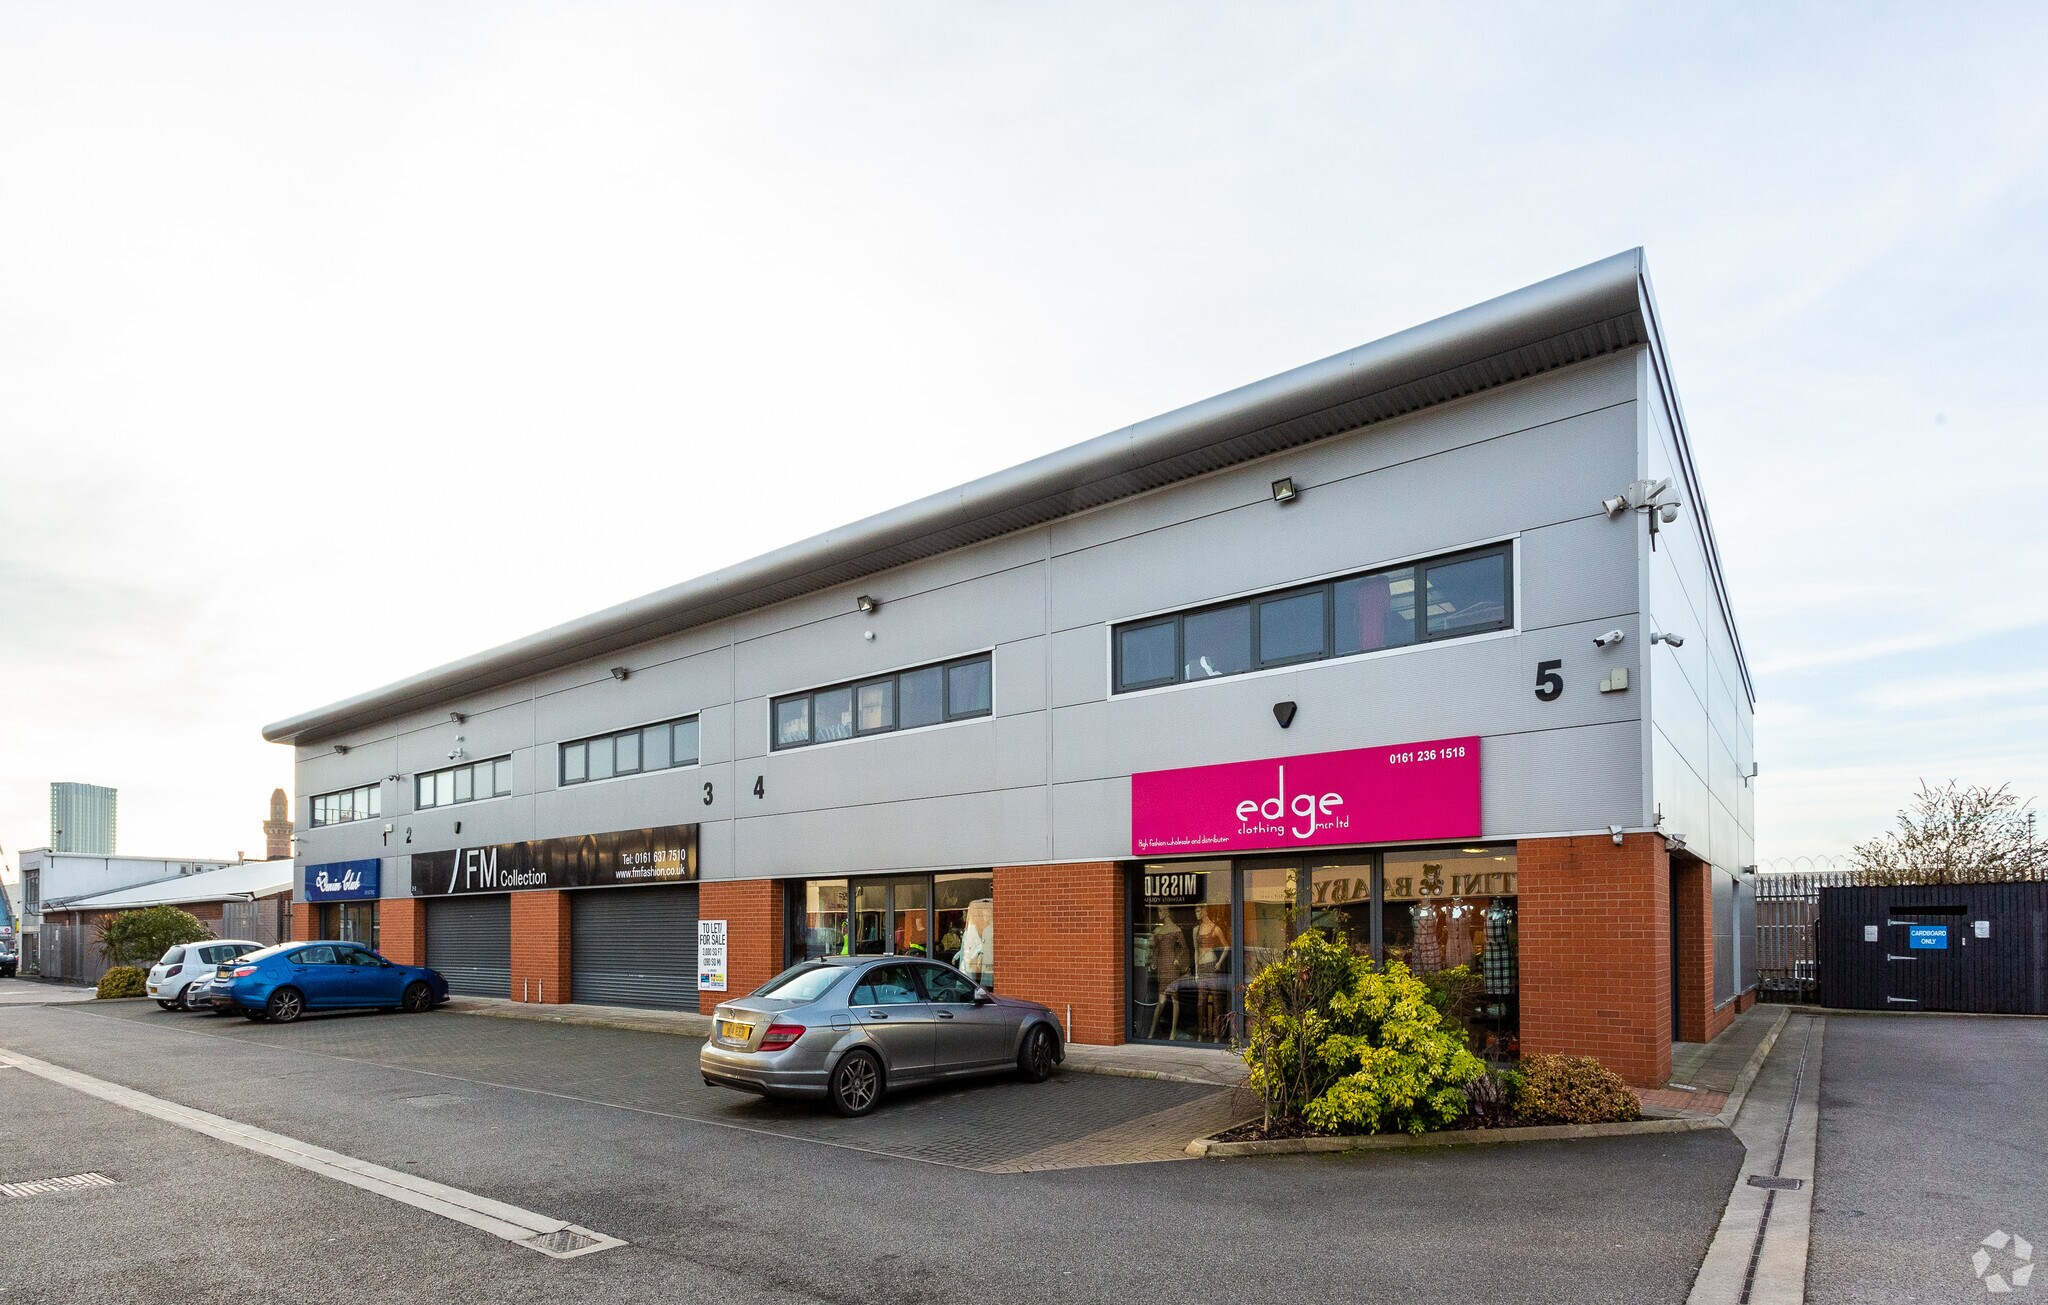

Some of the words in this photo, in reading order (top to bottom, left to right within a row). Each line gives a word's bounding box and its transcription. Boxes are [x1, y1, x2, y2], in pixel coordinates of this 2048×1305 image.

[1535, 659, 1563, 701] 5
[1390, 752, 1413, 764] 0161
[1417, 750, 1436, 762] 236
[1440, 747, 1465, 758] 1518
[703, 782, 713, 805] 3
[754, 775, 764, 799] 4
[1236, 765, 1343, 838] edge
[1238, 822, 1284, 836] clothing
[1336, 815, 1349, 828] ltd
[406, 827, 412, 843] 2
[1149, 838, 1166, 847] fashion
[1166, 836, 1190, 846] wholesale
[1191, 834, 1201, 844] and
[622, 853, 634, 865] Tel:
[635, 852, 651, 864] 0161
[653, 850, 666, 862] 637
[668, 848, 686, 860] 7510
[466, 848, 497, 889] FM
[500, 868, 547, 887] Collection
[616, 864, 685, 879] www.fmfashion.co.uk
[702, 923, 710, 934] TO
[699, 935, 710, 945] FOR
[711, 934, 726, 945] SALE
